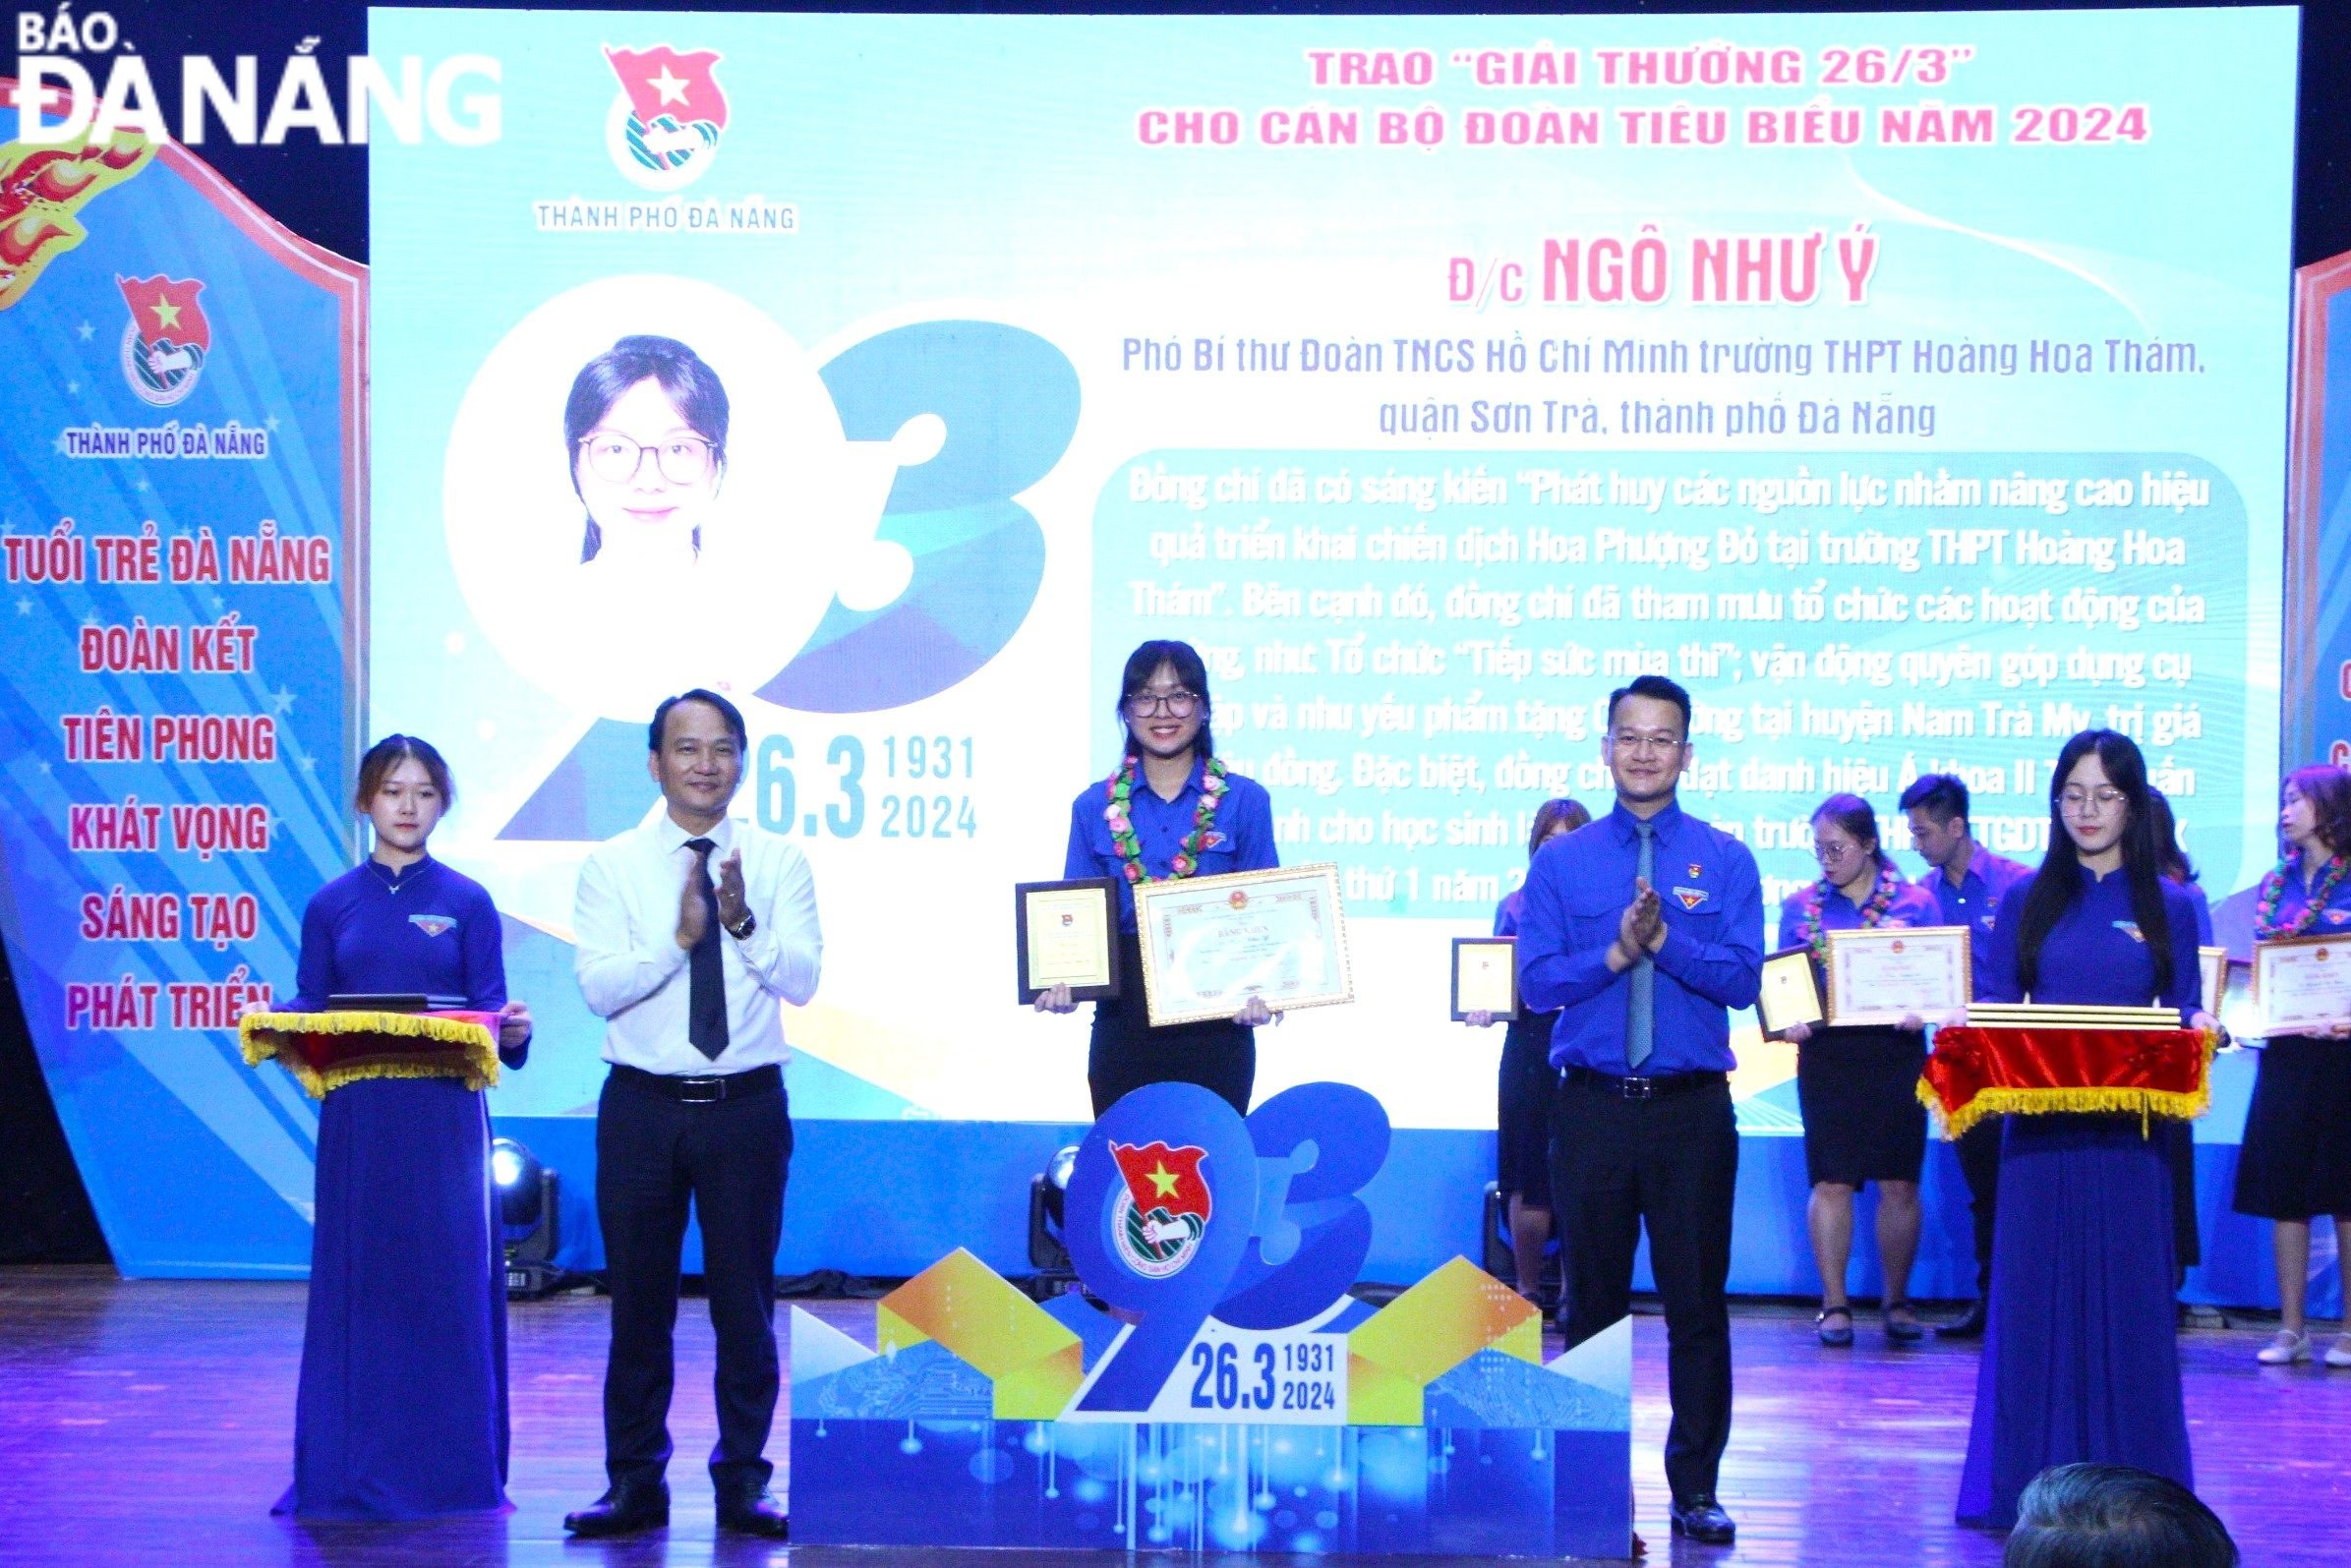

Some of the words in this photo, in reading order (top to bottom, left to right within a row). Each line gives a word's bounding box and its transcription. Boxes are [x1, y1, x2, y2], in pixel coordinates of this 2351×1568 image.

[1309, 52, 1433, 85] TRAO
[1139, 111, 1239, 145] CHO
[1380, 104, 1444, 151] BỘ
[1619, 104, 1726, 144] TIÊU
[2013, 106, 2147, 143] 2024
[1544, 223, 1667, 303] NGÔ
[1691, 233, 1823, 303] NHƯ
[1838, 223, 1876, 303] Ý
[1123, 335, 1182, 372] Phó
[1194, 335, 1226, 372] Bí
[1237, 338, 1291, 372] thư
[1300, 336, 1382, 373] Đoàn
[1393, 339, 1475, 373] TNCS
[1486, 330, 1527, 374] Hồ
[1539, 336, 1592, 374] Chí
[1604, 338, 1688, 374] Minh
[1699, 336, 1813, 377] trường
[1824, 340, 1903, 374] THPT
[1913, 336, 2018, 377] Hoàng
[2029, 340, 2094, 374] Hoa
[67, 424, 130, 454] THÀNH
[138, 421, 178, 454] PHỐ
[183, 425, 208, 455] ĐÀ
[214, 421, 265, 455] NẴNG
[1379, 396, 1459, 440] quận
[1471, 399, 1533, 434] Sơn
[1621, 397, 1714, 435] thành
[1726, 391, 1788, 438] phố
[1797, 397, 1841, 436] Đà
[1852, 392, 1937, 438] Nẵng
[1316, 468, 1353, 504] có
[1361, 467, 1437, 512] sáng
[1443, 463, 1508, 504] kiến
[1610, 471, 1667, 514] huy
[1675, 469, 1731, 506] các
[1737, 464, 1832, 514] nguồn
[1839, 471, 1888, 513] lực
[1895, 467, 1981, 506] nhằm
[1989, 471, 2069, 515] nâng
[2075, 478, 2134, 507] cao
[2141, 471, 2209, 514] hiệu
[5, 518, 84, 582] TUỔI
[94, 523, 159, 582] TRẺ
[171, 529, 220, 582] ĐÀ
[230, 520, 330, 582] NẴNG
[1293, 525, 1357, 561] khai
[1366, 520, 1447, 561] chiến
[1455, 525, 1520, 568] dịch
[1528, 527, 1587, 563] Hoa
[1595, 527, 1711, 571] Phượng
[1767, 527, 1810, 570] tại
[1818, 528, 1921, 573] trường
[1926, 527, 2009, 565] THPT
[2016, 528, 2118, 573] Hoàng
[2123, 529, 2188, 565] Hoa
[1242, 581, 1304, 617] Bên
[1309, 582, 1383, 624] cạnh
[1445, 577, 1524, 627] đồng
[1528, 584, 1574, 620] chí
[1582, 585, 1622, 621] đã
[1631, 585, 1711, 621] tham
[1717, 588, 1784, 621] mưu
[1792, 577, 1827, 622] tổ
[1834, 585, 1910, 622] chức
[1915, 586, 1975, 622] các
[1981, 587, 2054, 630] hoạt
[2061, 586, 2142, 632] động
[2146, 583, 2206, 623] của
[82, 618, 179, 671] ĐOÀN
[191, 612, 257, 671] KẾT
[1372, 639, 1447, 675] chức
[1540, 641, 1596, 677] sức
[1604, 640, 1670, 677] mùa
[1751, 643, 1807, 685] vận
[1815, 642, 1894, 687] động
[1899, 644, 1993, 688] quyên
[1999, 645, 2060, 688] góp
[2066, 644, 2146, 689] dụng
[2151, 651, 2193, 688] cụ
[63, 708, 142, 761] TIÊN
[153, 717, 274, 761] PHONG
[1252, 695, 1289, 730] và
[1360, 691, 1416, 739] yếu
[1424, 689, 1508, 739] phẩm
[1515, 699, 1586, 743] tặng
[1749, 700, 1793, 742] tại
[1801, 700, 1894, 744] huyện
[1903, 701, 1975, 737] Nam
[1980, 701, 2034, 737] Trà
[2150, 701, 2203, 746] giá
[882, 735, 973, 779] 1931
[1494, 749, 1574, 798] đồng
[1740, 756, 1816, 793] danh
[1823, 756, 1890, 798] hiệu
[71, 797, 161, 850] KHÁT
[172, 806, 267, 860] VỌNG
[881, 794, 976, 839] 2024
[1319, 808, 1375, 845] cho
[1382, 809, 1439, 851] học
[1444, 809, 1509, 846] sinh
[1344, 864, 1395, 901] thứ
[1403, 865, 1419, 901] 1
[1431, 865, 1499, 901] năm
[82, 887, 179, 940] SÁNG
[190, 896, 257, 949] TẠO
[67, 976, 157, 1029] PHÁT
[1191, 1342, 1276, 1410] 26.3
[1282, 1343, 1335, 1372] 1931
[1282, 1381, 1335, 1410] 2024
